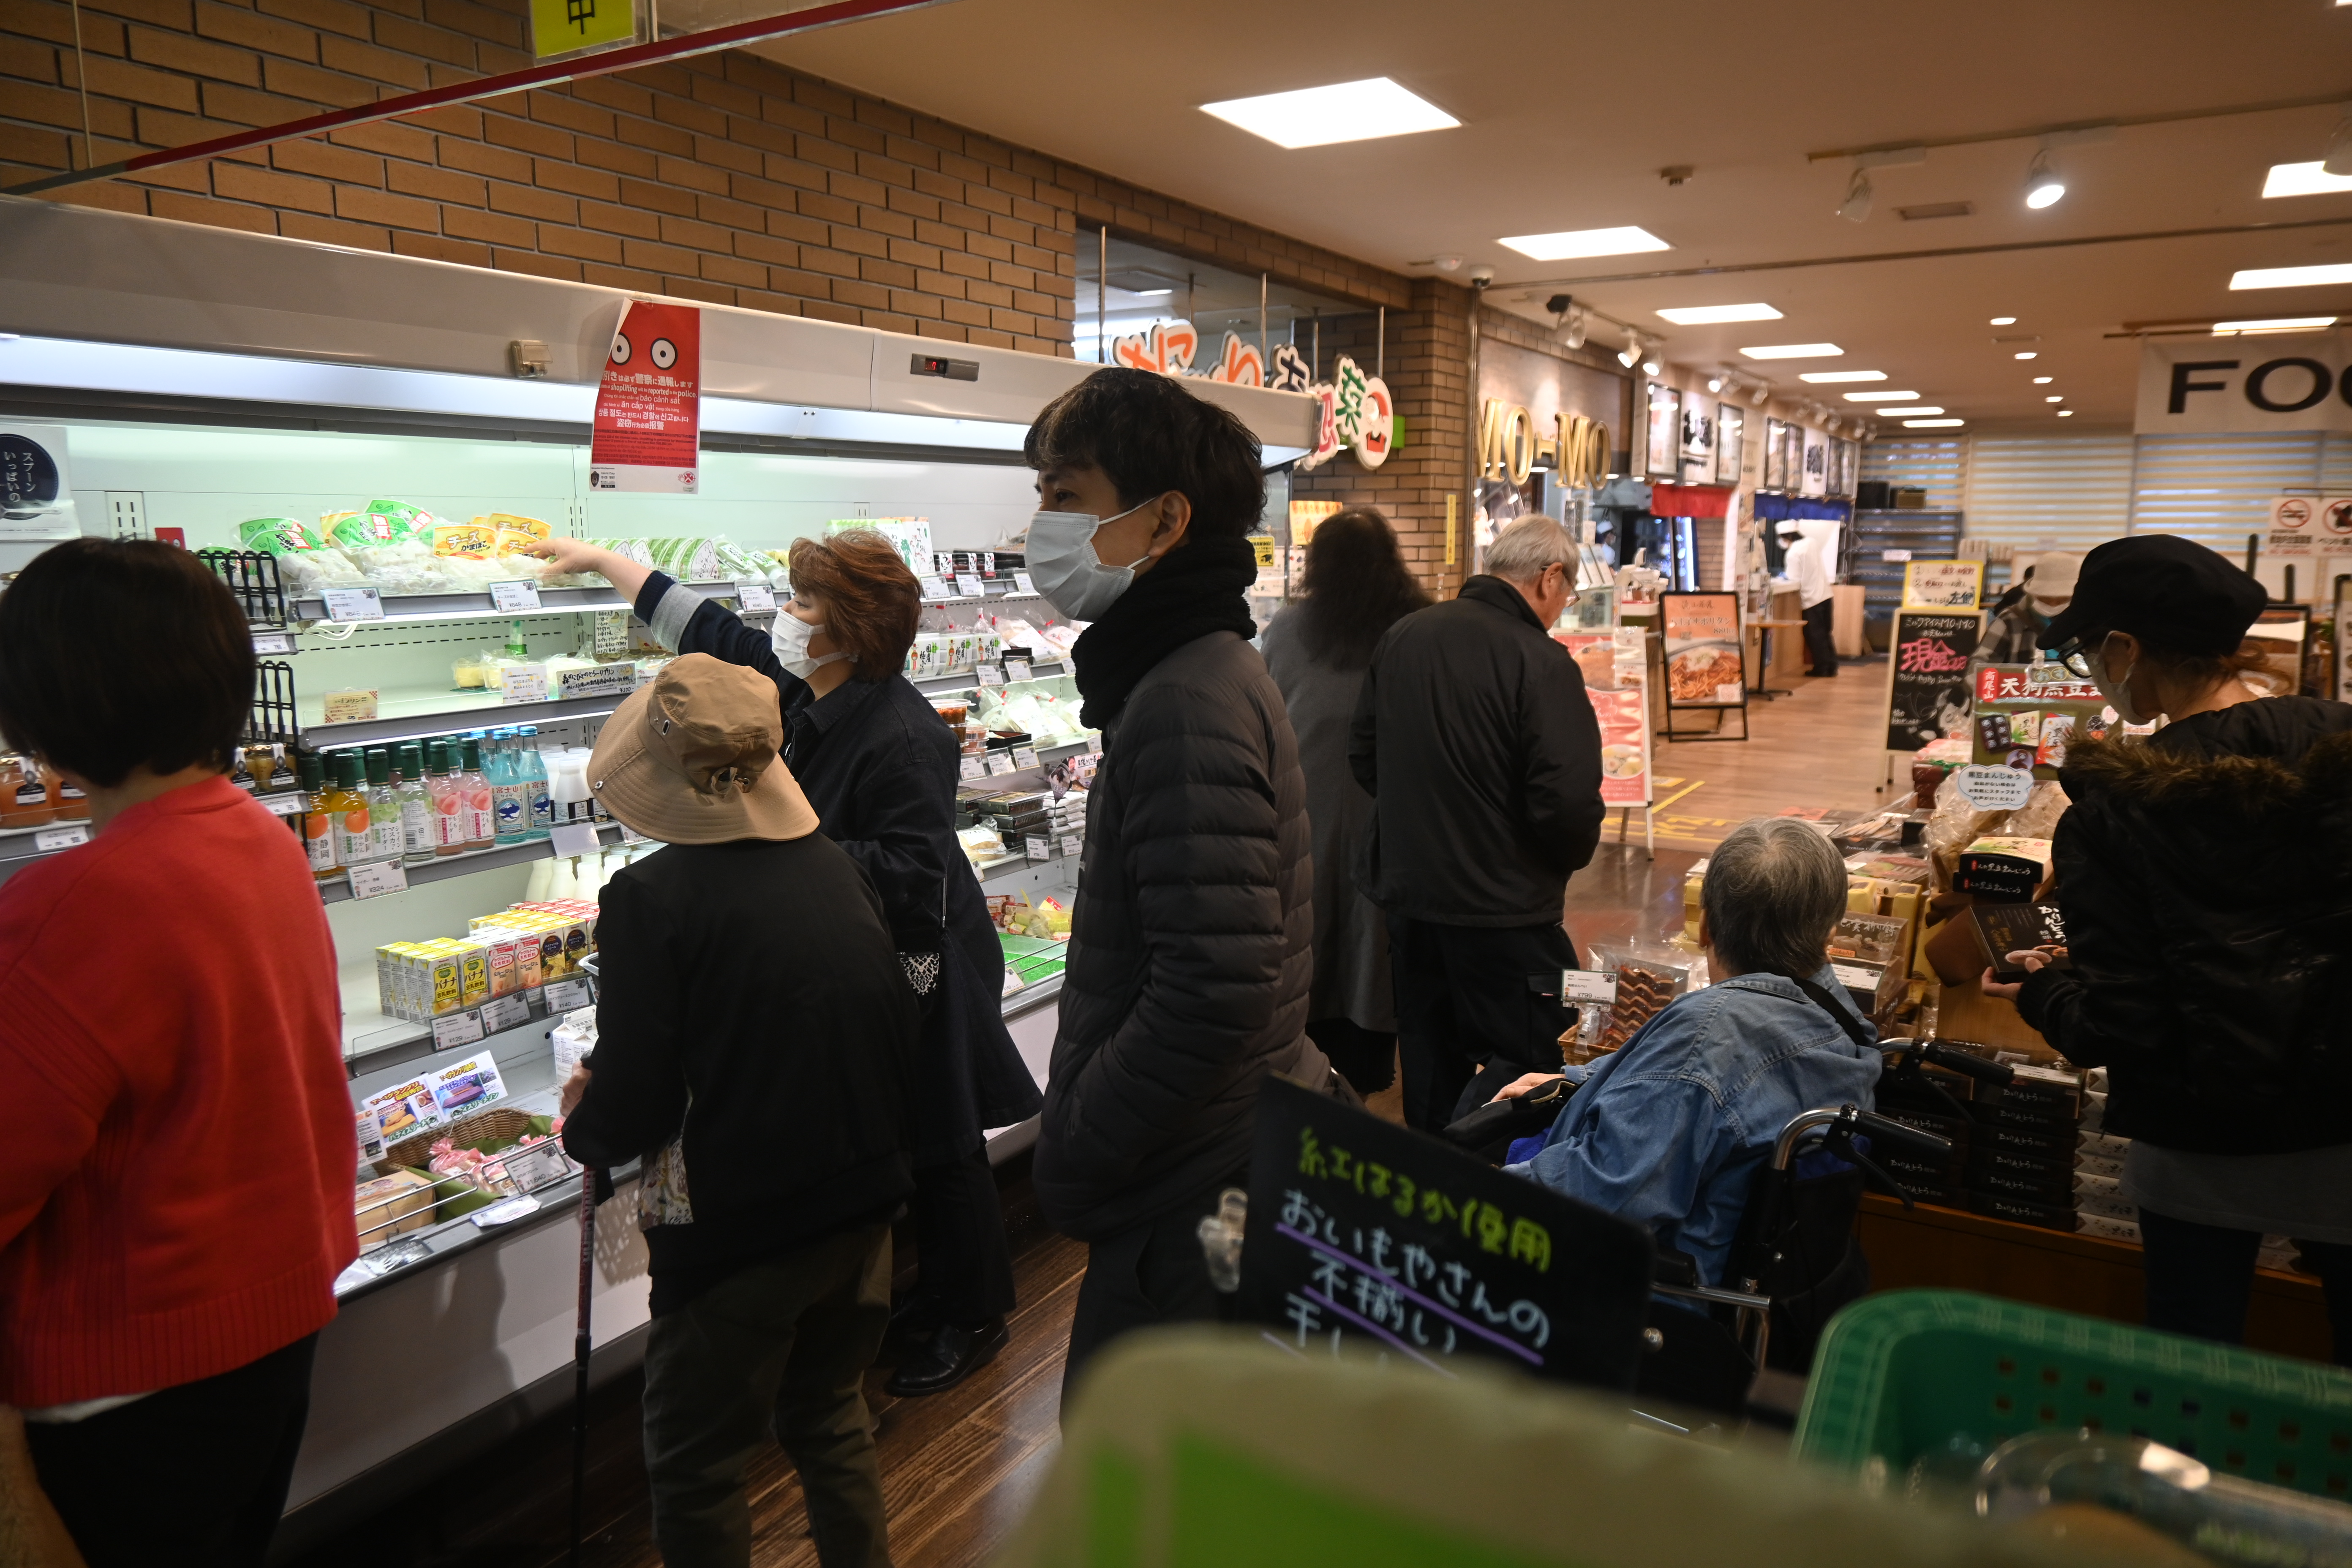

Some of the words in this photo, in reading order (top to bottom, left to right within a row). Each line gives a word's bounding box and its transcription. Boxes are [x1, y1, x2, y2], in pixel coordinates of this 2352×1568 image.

[611, 384, 637, 394] shoplifting
[2167, 357, 2352, 414] FO
[640, 394, 652, 402] báo
[1477, 397, 1611, 490] MO-MO
[4, 451, 21, 503] いっぱいの
[22, 452, 35, 493] スプーン
[447, 530, 480, 550] チーズ
[460, 541, 487, 552] かまぼこ
[1983, 670, 1996, 700] 高尾山
[1968, 771, 2022, 780] 黒豆まんじゅう
[496, 786, 519, 794] 富士山
[320, 839, 330, 859] 静岡
[435, 976, 457, 991] バナナ
[464, 969, 485, 983] バナナ
[585, 1171, 596, 1216] HAWK
[1297, 1124, 1552, 1273] 紅はるか使用
[583, 1220, 593, 1262] GEAR
